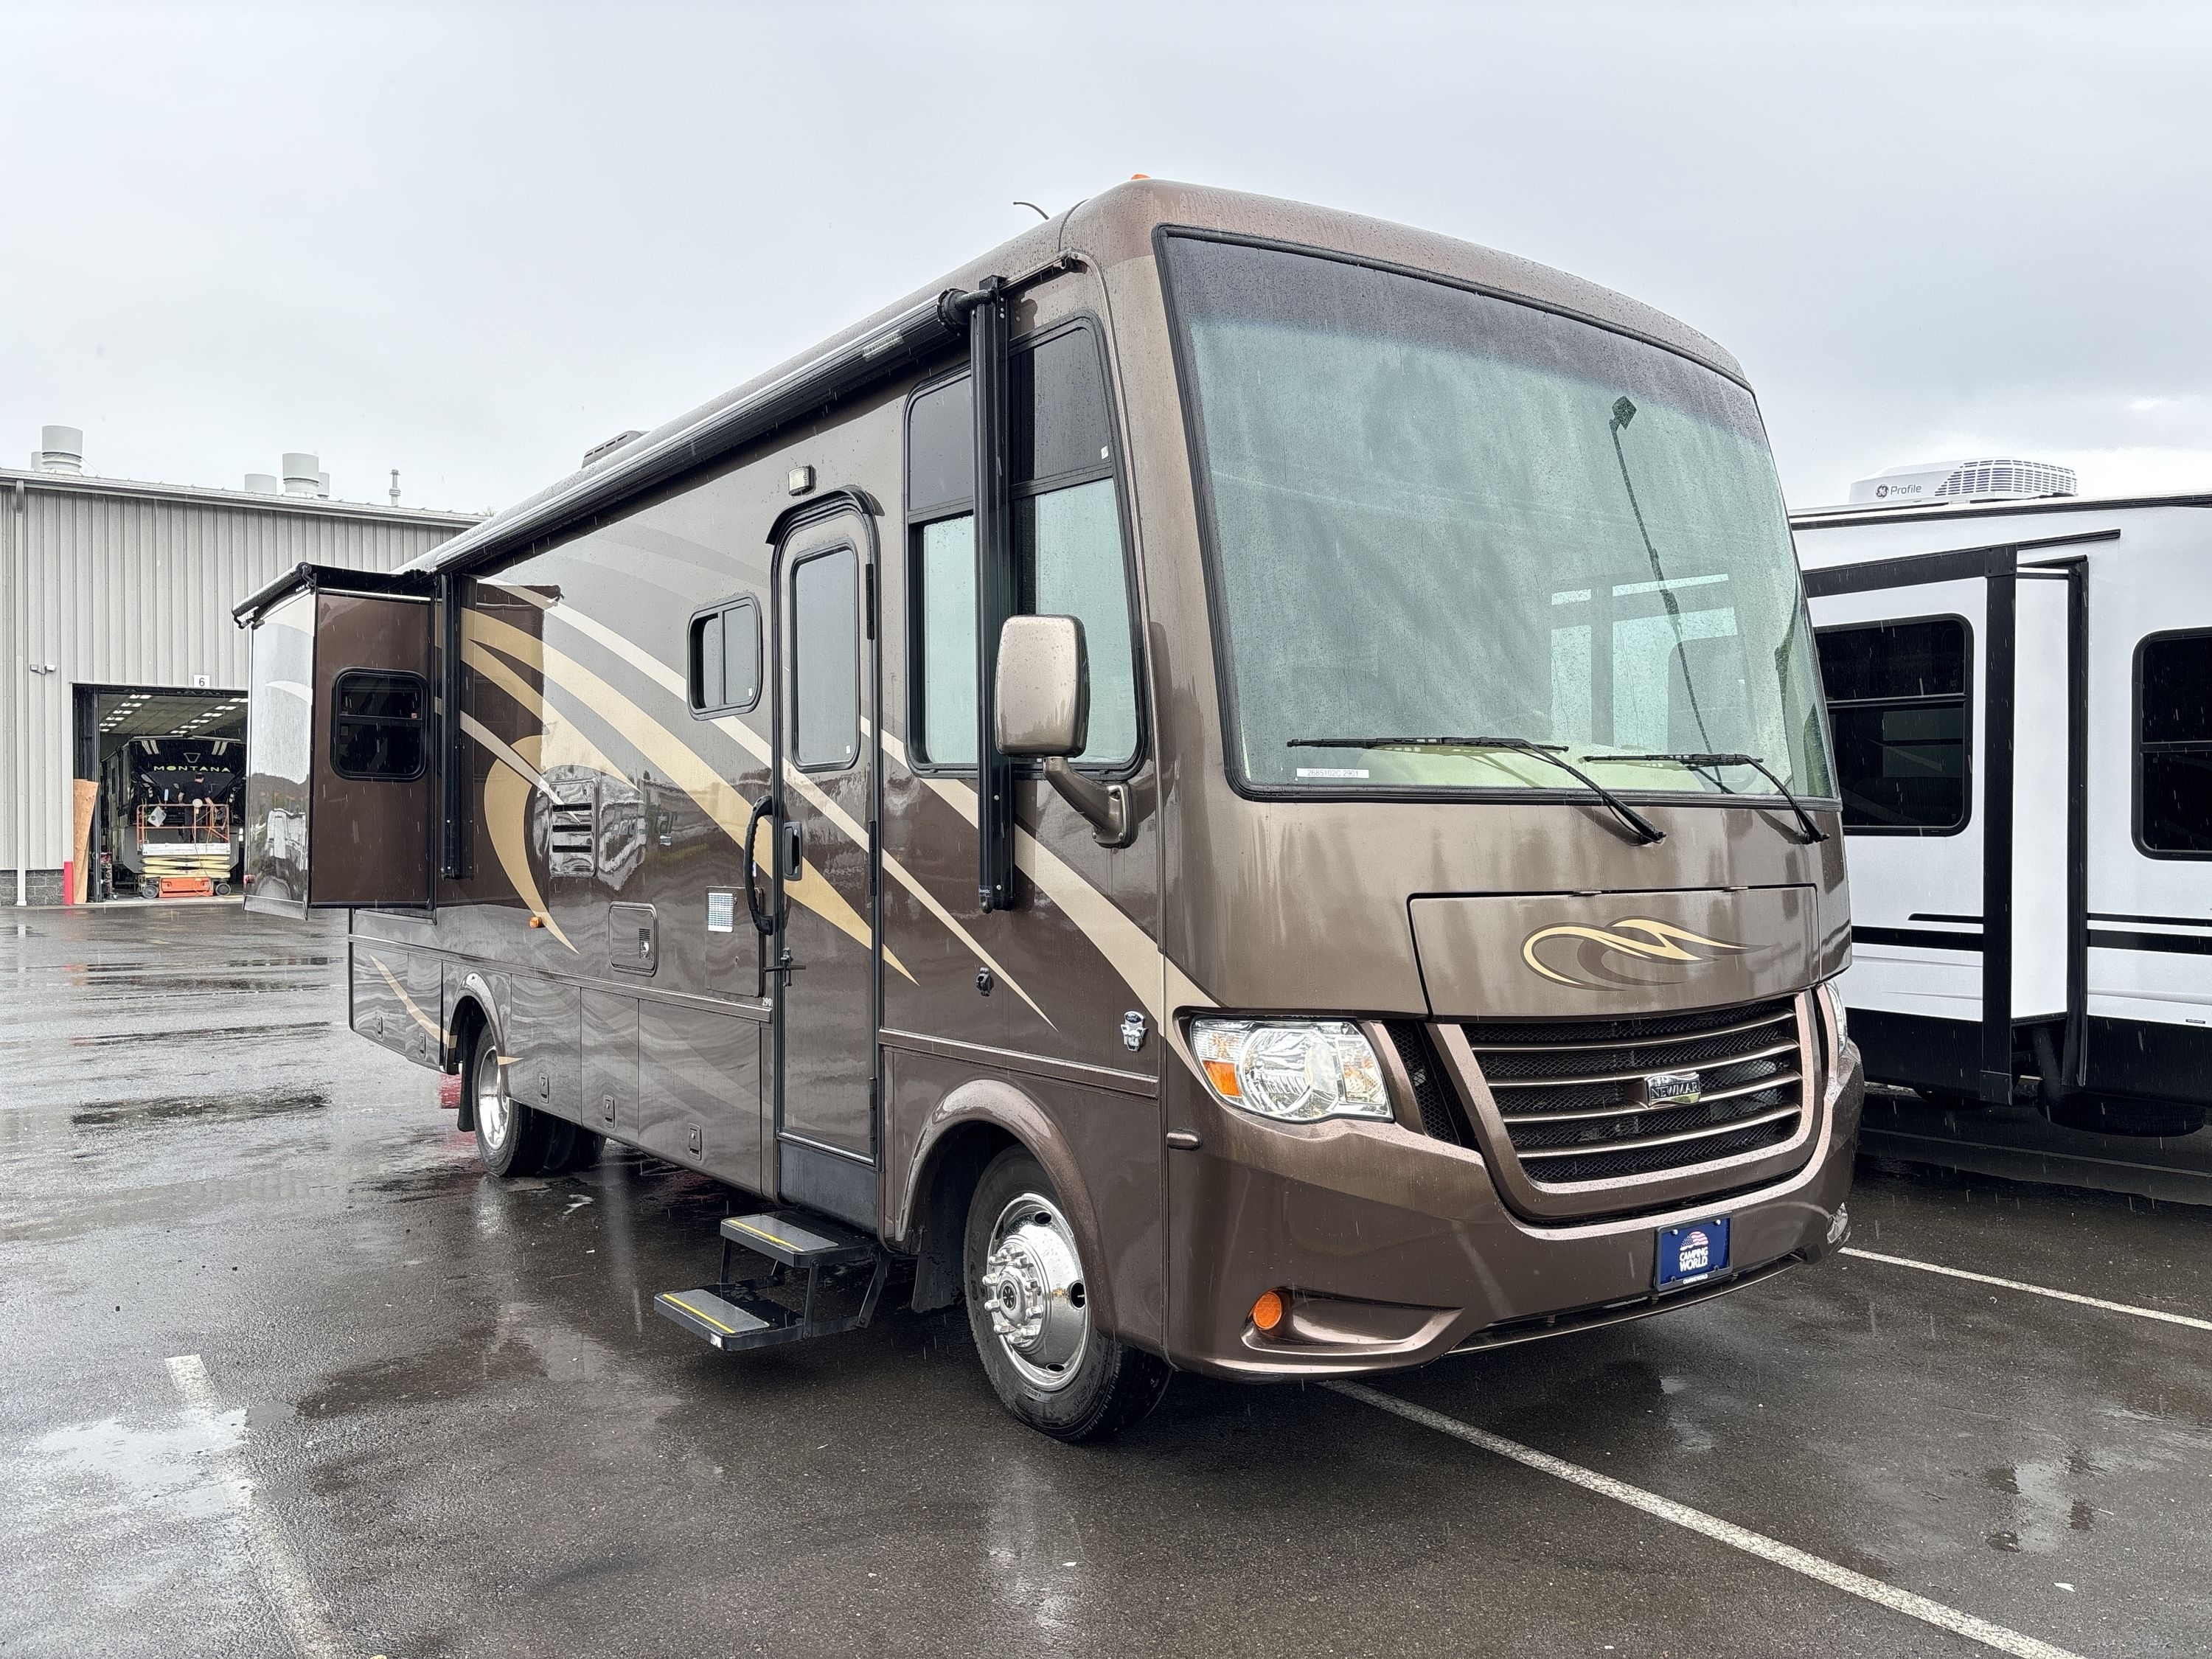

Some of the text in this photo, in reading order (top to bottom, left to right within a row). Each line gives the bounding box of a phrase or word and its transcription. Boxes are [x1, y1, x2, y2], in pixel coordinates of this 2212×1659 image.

[1891, 484, 1921, 495] Profile
[198, 677, 205, 686] 6
[1651, 1082, 1700, 1098] NEWMAR
[1680, 1247, 1708, 1262] CAMPING
[1680, 1256, 1708, 1272] WORLD
